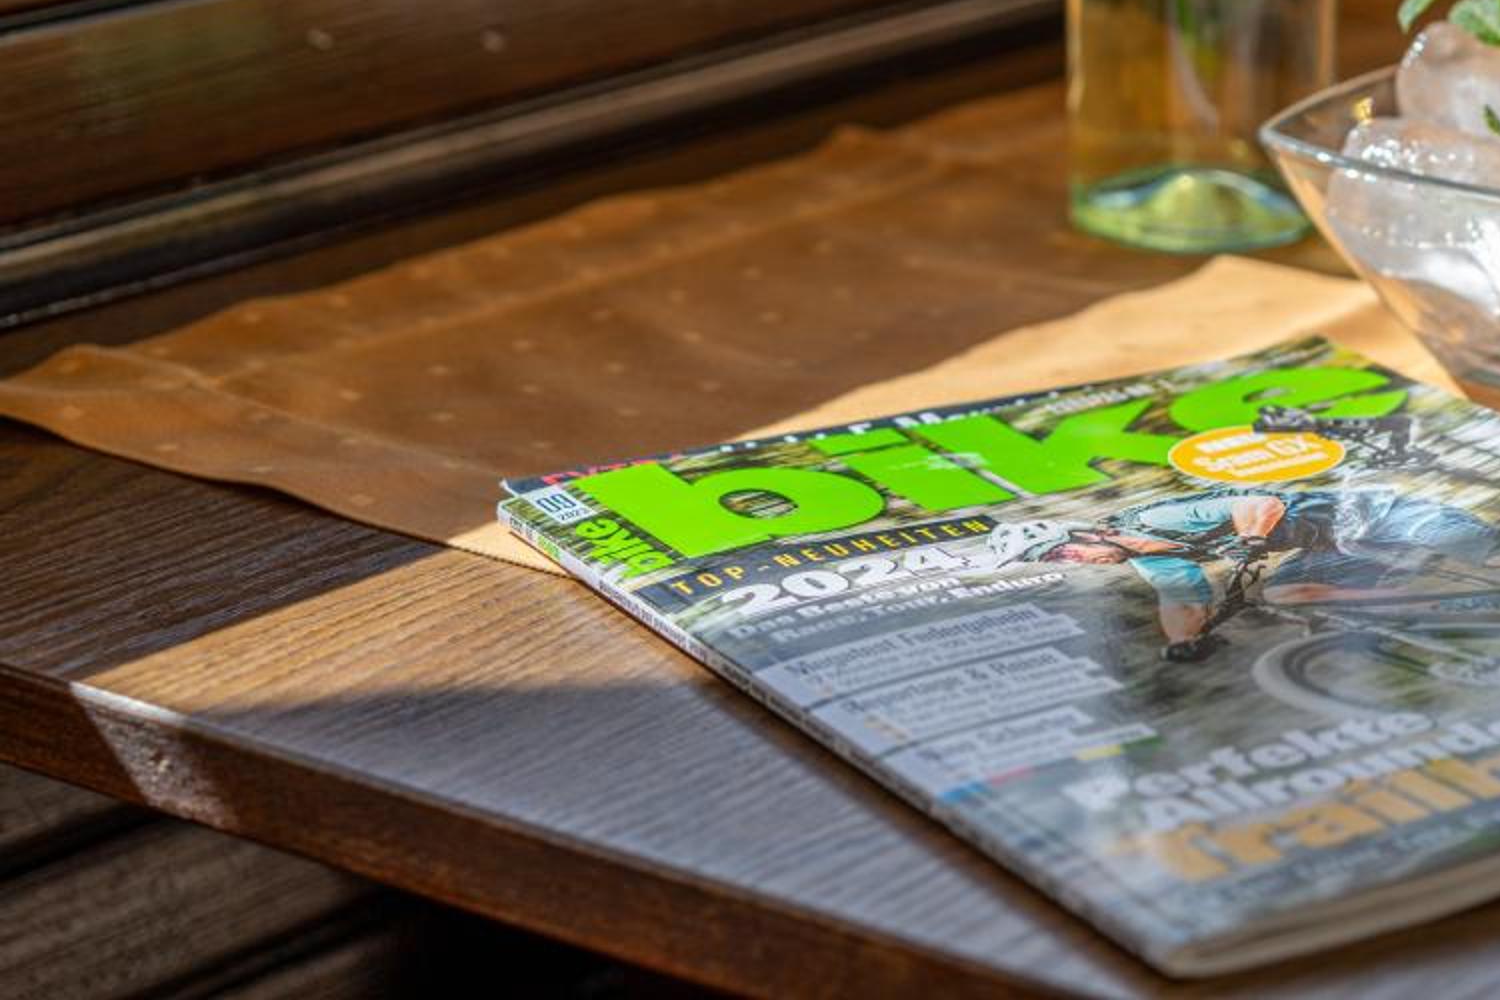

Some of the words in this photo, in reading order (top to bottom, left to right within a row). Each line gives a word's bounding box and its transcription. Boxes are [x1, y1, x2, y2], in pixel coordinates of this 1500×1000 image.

[570, 367, 1408, 558] bike
[535, 491, 579, 513] 09
[575, 518, 675, 579] bike
[721, 546, 968, 617] 2024
[948, 571, 1066, 602] Enduro
